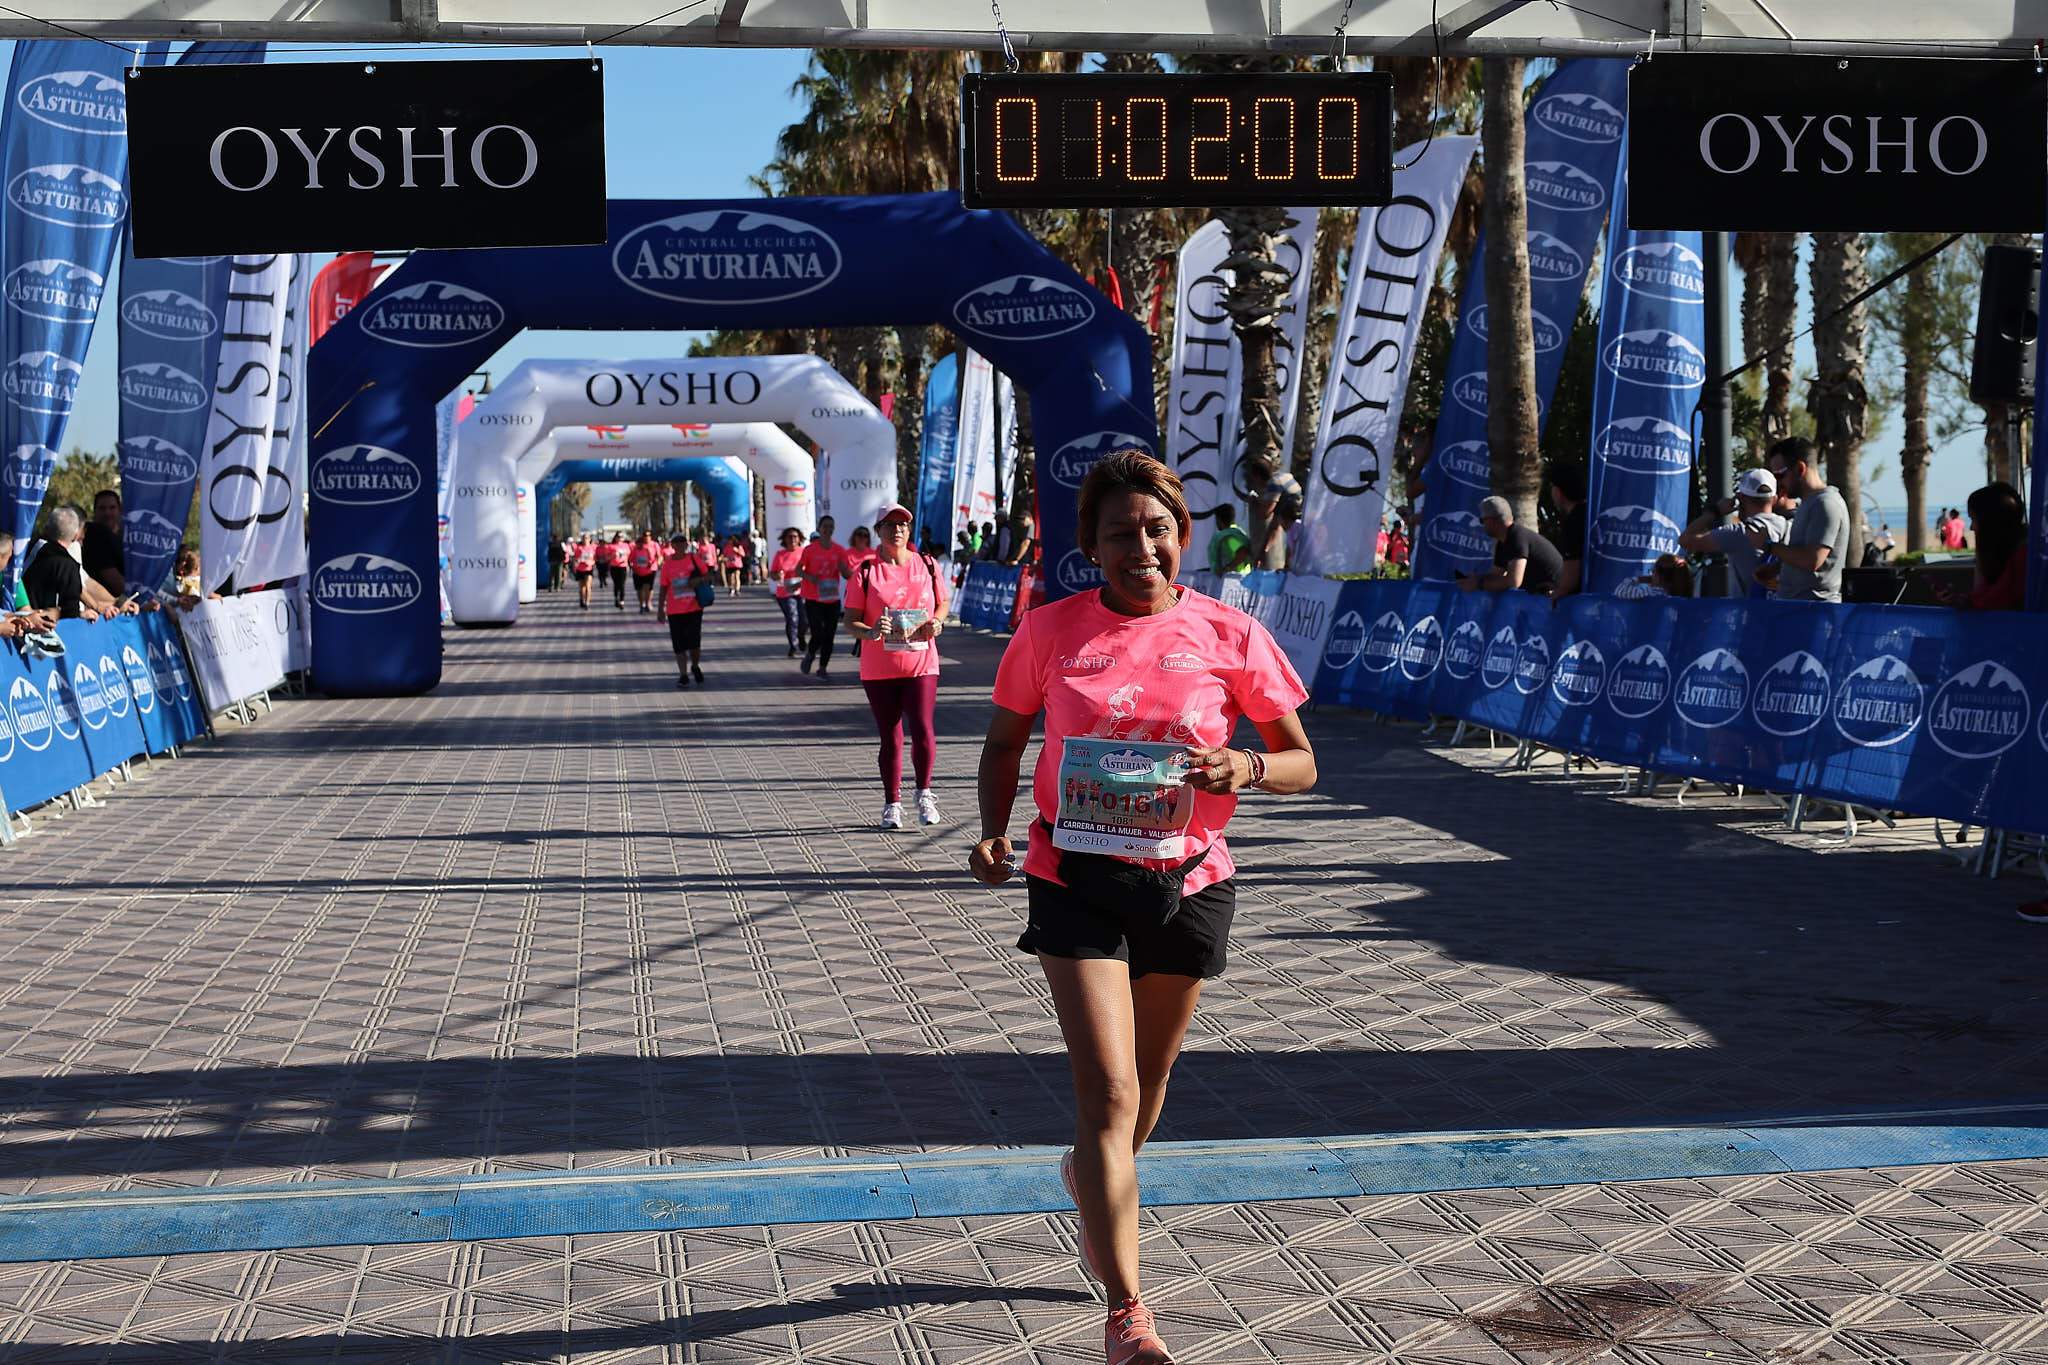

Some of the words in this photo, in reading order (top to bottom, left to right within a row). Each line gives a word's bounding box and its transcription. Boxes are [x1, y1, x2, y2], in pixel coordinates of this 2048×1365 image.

[27, 85, 127, 123] ASTURIAN
[1540, 101, 1619, 137] ASTURIANA
[995, 97, 1358, 182] 01:02:00
[1699, 113, 1989, 176] OYSHO
[209, 124, 539, 192] OYSHO
[17, 179, 119, 218] ASTURIAN
[1526, 179, 1597, 205] STURIANA
[665, 237, 737, 248] CENTRAL
[745, 237, 817, 248] LECHERA
[631, 239, 825, 280] ASTURIANA
[1529, 253, 1575, 276] RIANA
[1621, 256, 1704, 294] ASTURIAN
[10, 276, 99, 312] ASTURIAN
[127, 301, 209, 333] ASTURIANA
[368, 307, 494, 331] ASTURIANA
[965, 300, 1087, 325] ASTURIANA
[1611, 344, 1701, 381] ASTURIANA
[121, 375, 199, 406] ASTURIANA
[585, 370, 762, 408] OYSHO
[479, 414, 533, 427] OYSHO
[811, 407, 865, 419] OYSHO
[127, 456, 188, 478] STURIANA
[1446, 453, 1490, 479] ASTURI
[315, 468, 414, 491] ASTURIANA
[457, 485, 509, 498] OYSHO
[840, 478, 889, 491] OYSHO
[1431, 522, 1492, 553] ASTURIAN
[1600, 530, 1674, 554] TURIANA
[457, 557, 508, 570] OYSHO
[315, 576, 414, 599] ASTURIANA
[1061, 655, 1116, 669] OYSHO
[1609, 671, 1664, 701] ASTURIANA
[1678, 676, 1742, 710] ASTURIANA
[1756, 682, 1822, 717] ASTURIANA
[1838, 685, 1914, 726] ASTURIANA
[1933, 694, 2019, 736] ASTURIANA
[1101, 757, 1153, 771] ASTURIANA
[1063, 820, 1095, 831] CARRERA
[1096, 824, 1106, 832] DE
[1107, 825, 1117, 834] LA
[1118, 827, 1142, 836] MUJER
[1067, 834, 1110, 847] OYSHO
[1134, 843, 1172, 853] Santander
